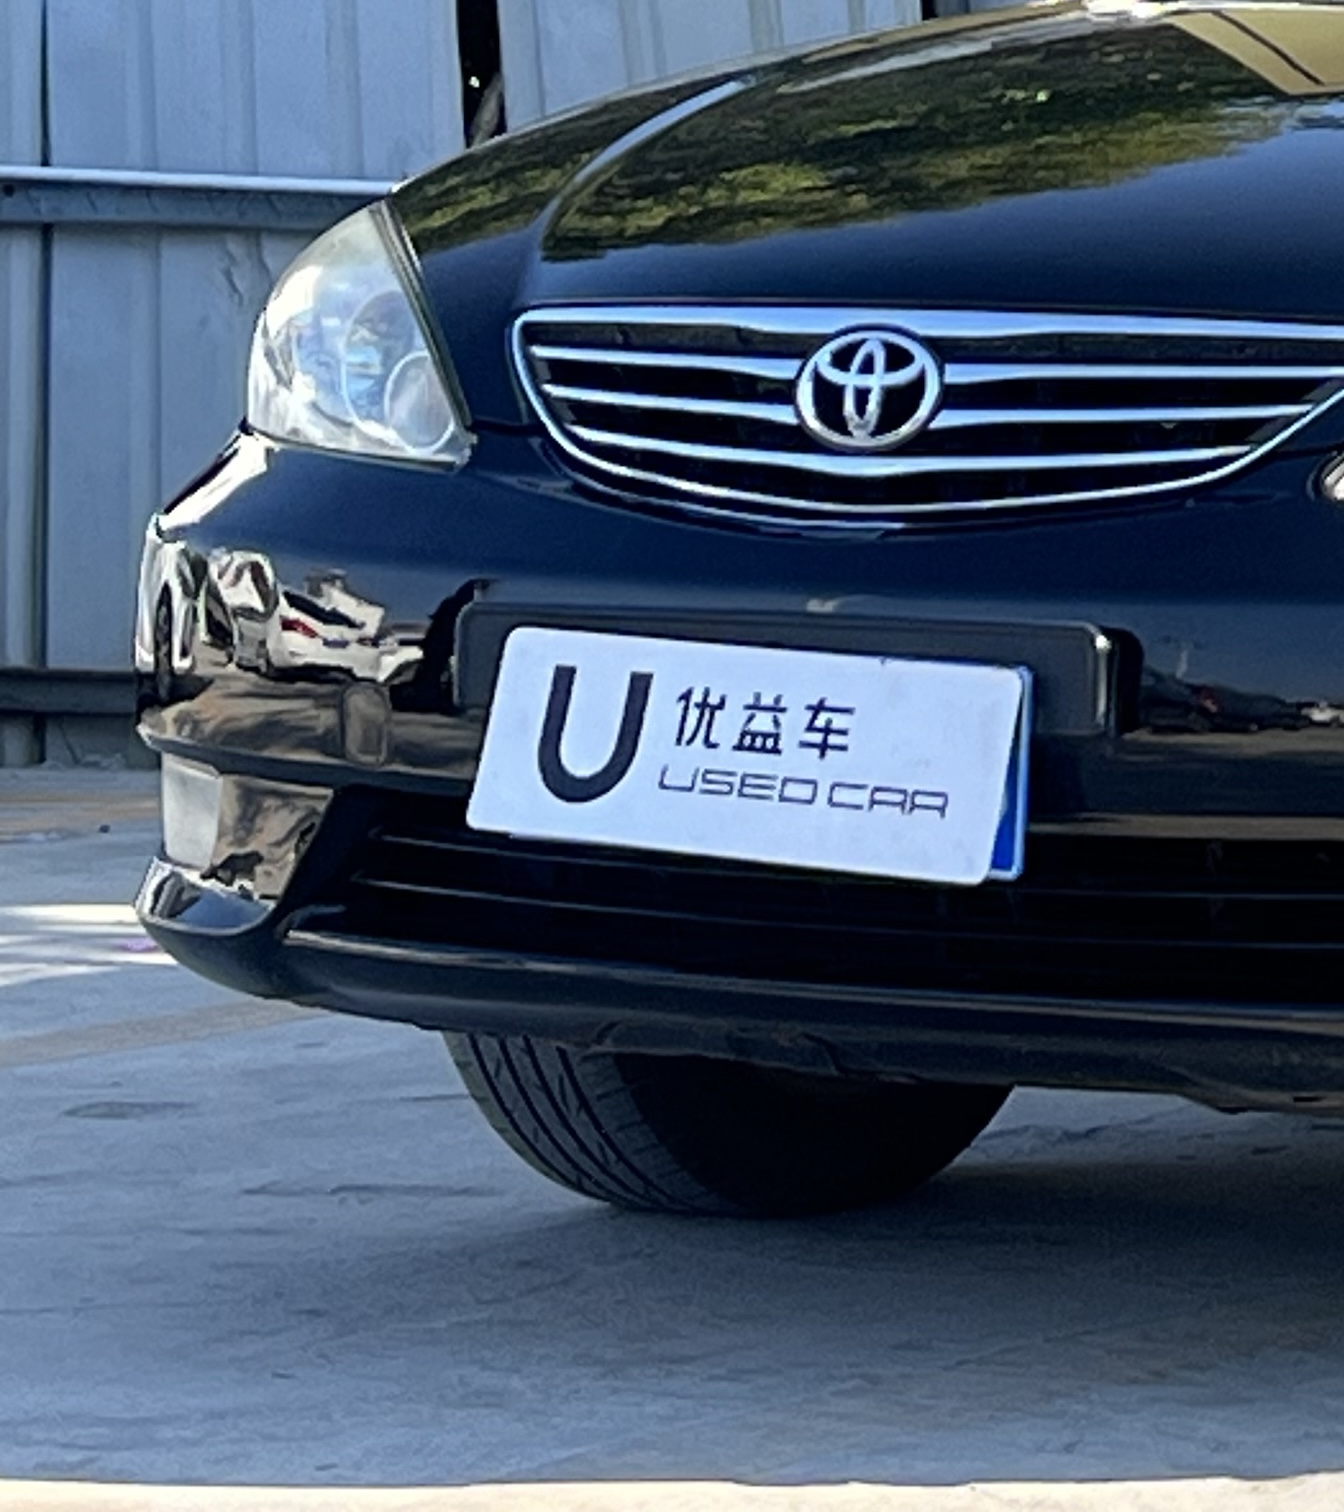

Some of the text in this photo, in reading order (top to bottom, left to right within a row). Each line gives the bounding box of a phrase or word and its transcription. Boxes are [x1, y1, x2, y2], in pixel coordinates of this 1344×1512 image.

[676, 687, 856, 760] 优益车
[658, 764, 949, 819] USED CAR
